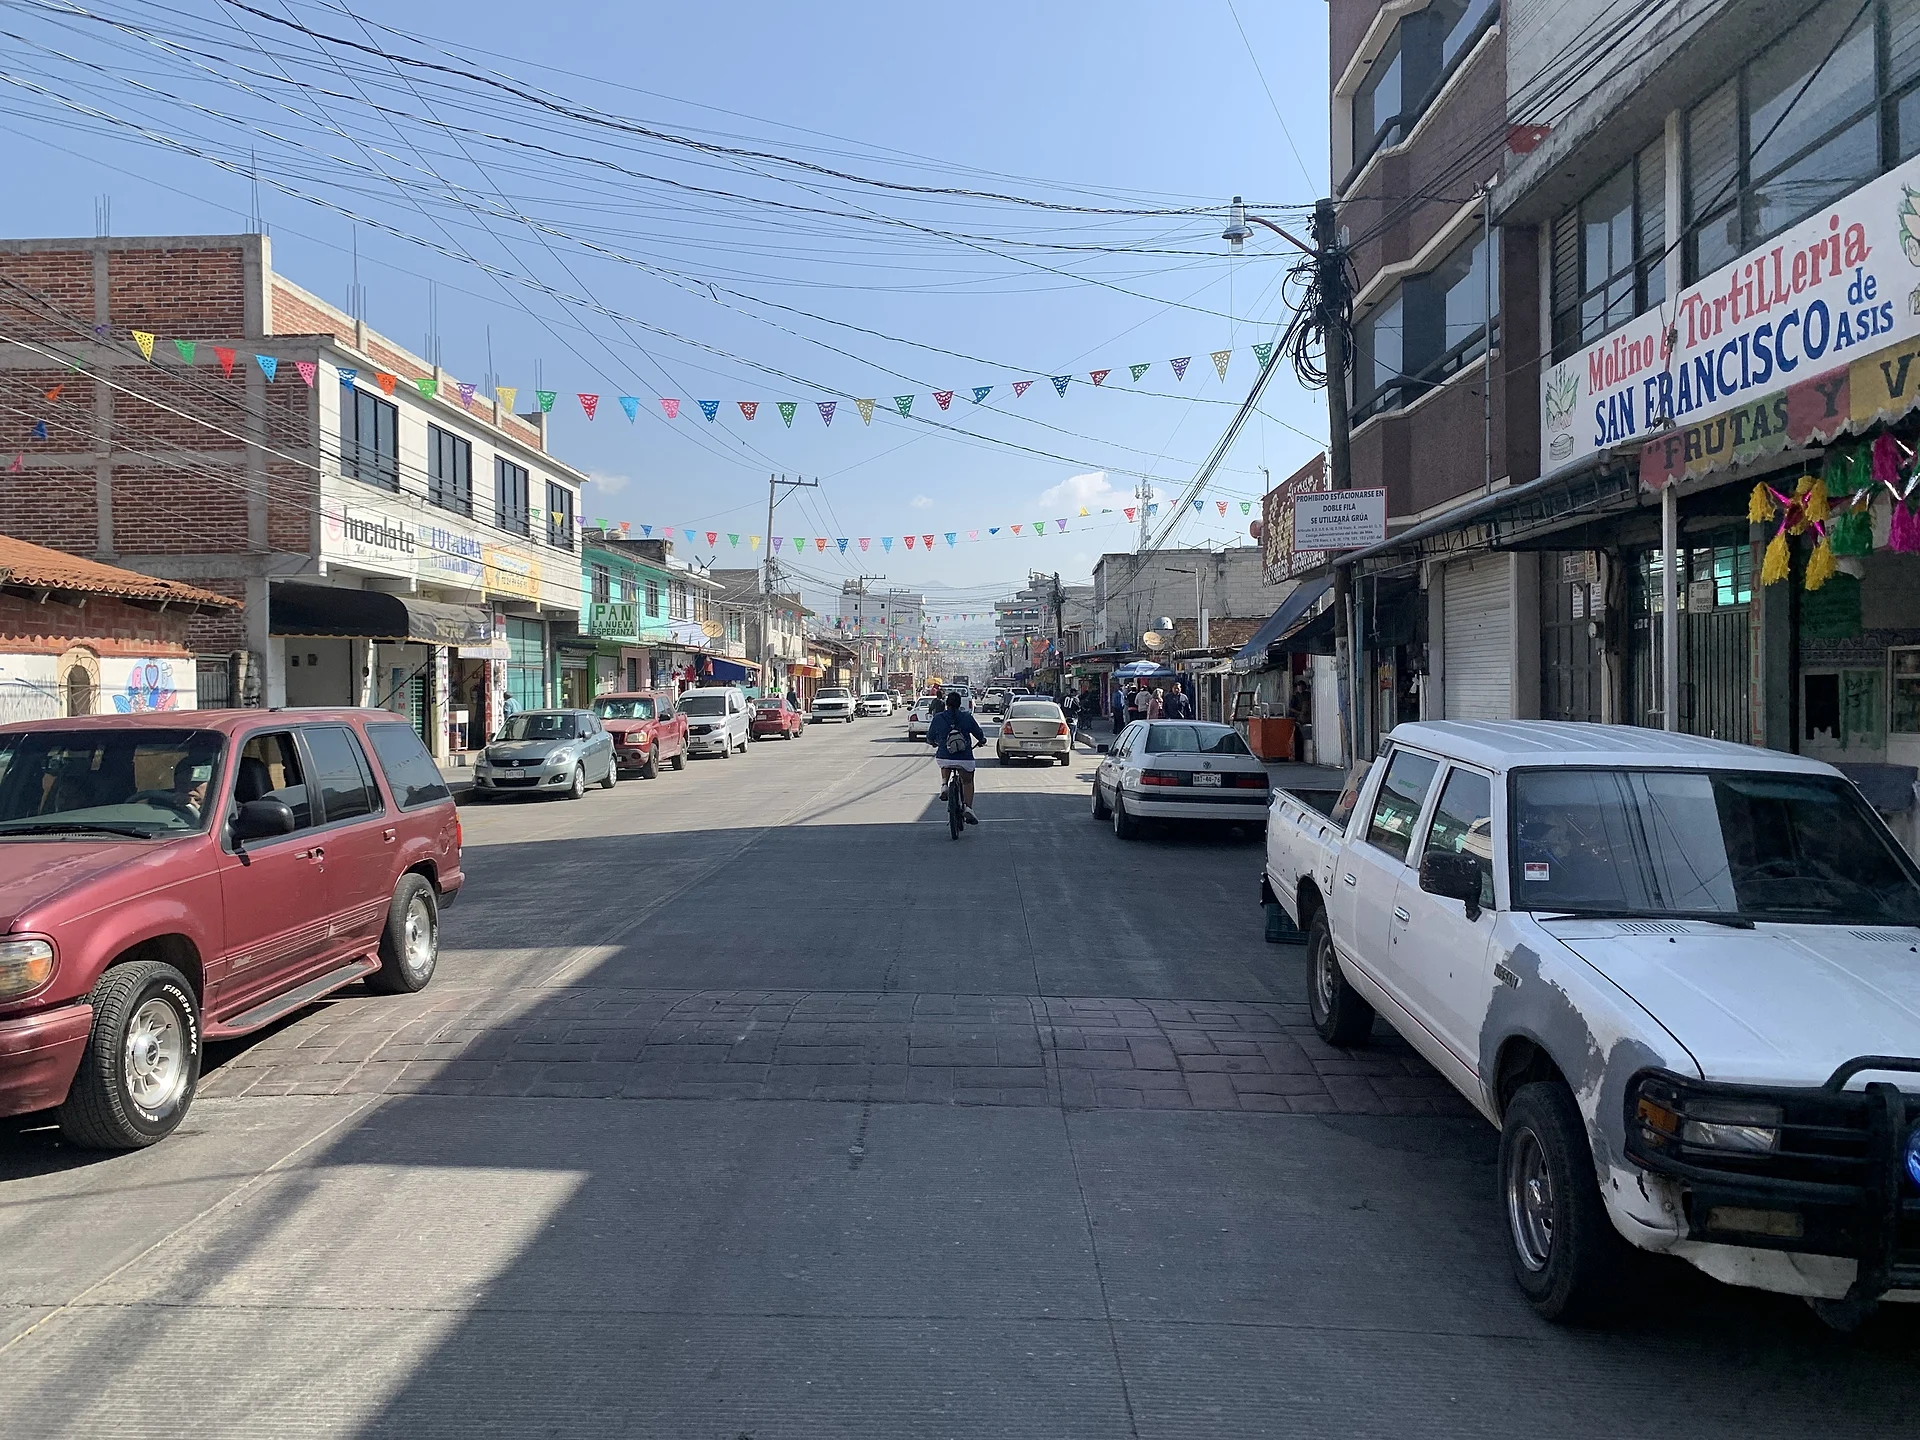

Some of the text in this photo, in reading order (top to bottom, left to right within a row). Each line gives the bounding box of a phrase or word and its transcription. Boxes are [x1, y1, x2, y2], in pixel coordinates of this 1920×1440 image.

[1594, 267, 1894, 447] SAN FRANCISCO de ASIS
[1816, 377, 1847, 418] Y
[1296, 489, 1384, 503] PROHIBIDO ESTACIONARSE EN
[1322, 503, 1356, 513] DOBLE FILA
[1310, 512, 1369, 525] SE UTILIZARÁ GRÚA
[596, 605, 631, 620] PAN
[592, 620, 634, 628] LA NUEVA
[592, 628, 635, 636] ESPERANZA
[162, 984, 198, 1056] FIREHAWK
